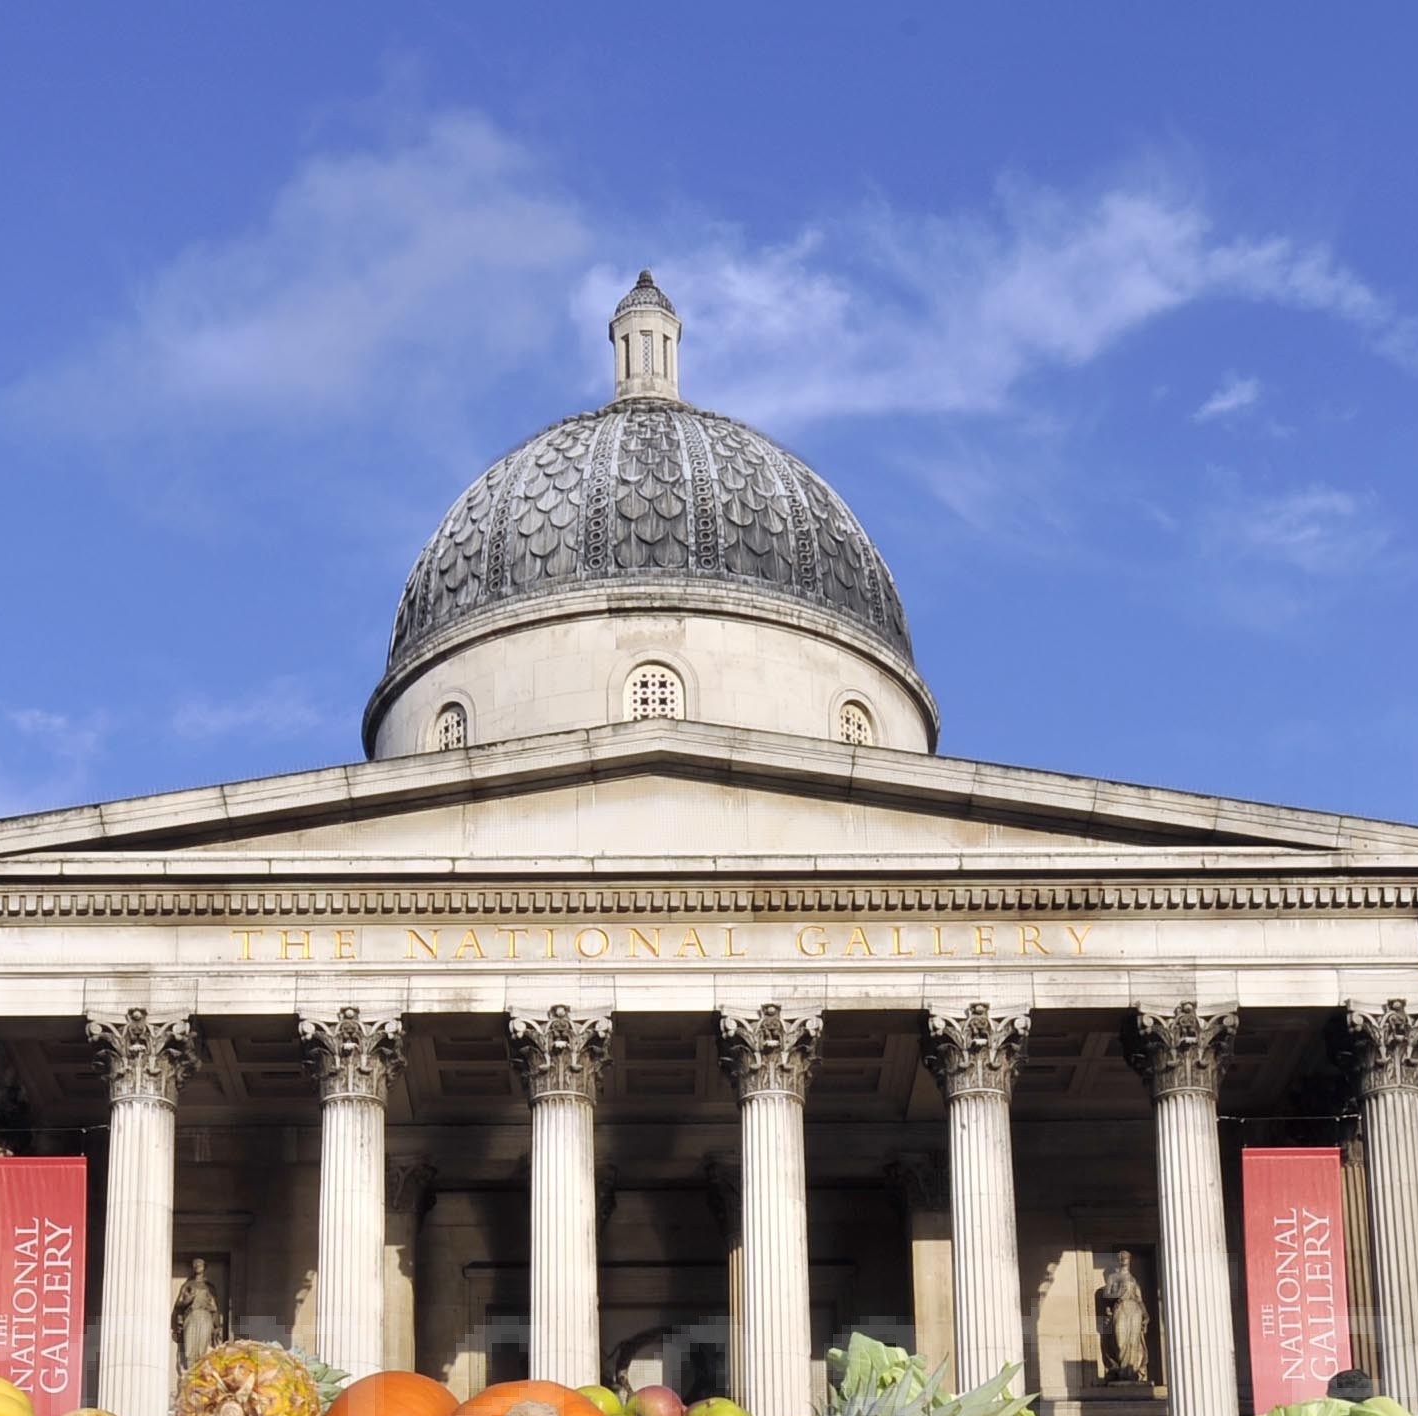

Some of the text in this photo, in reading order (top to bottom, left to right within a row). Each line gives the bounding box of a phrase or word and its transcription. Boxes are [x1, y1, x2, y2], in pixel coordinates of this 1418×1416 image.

[230, 924, 1094, 961] THE NATIONAL GALLERY
[10, 1217, 41, 1393] NATIONAL
[39, 1217, 74, 1394] GALLERY
[1261, 1303, 1275, 1339] THE
[1274, 1207, 1306, 1382] NATIONAL
[1302, 1207, 1340, 1383] GALLERY
